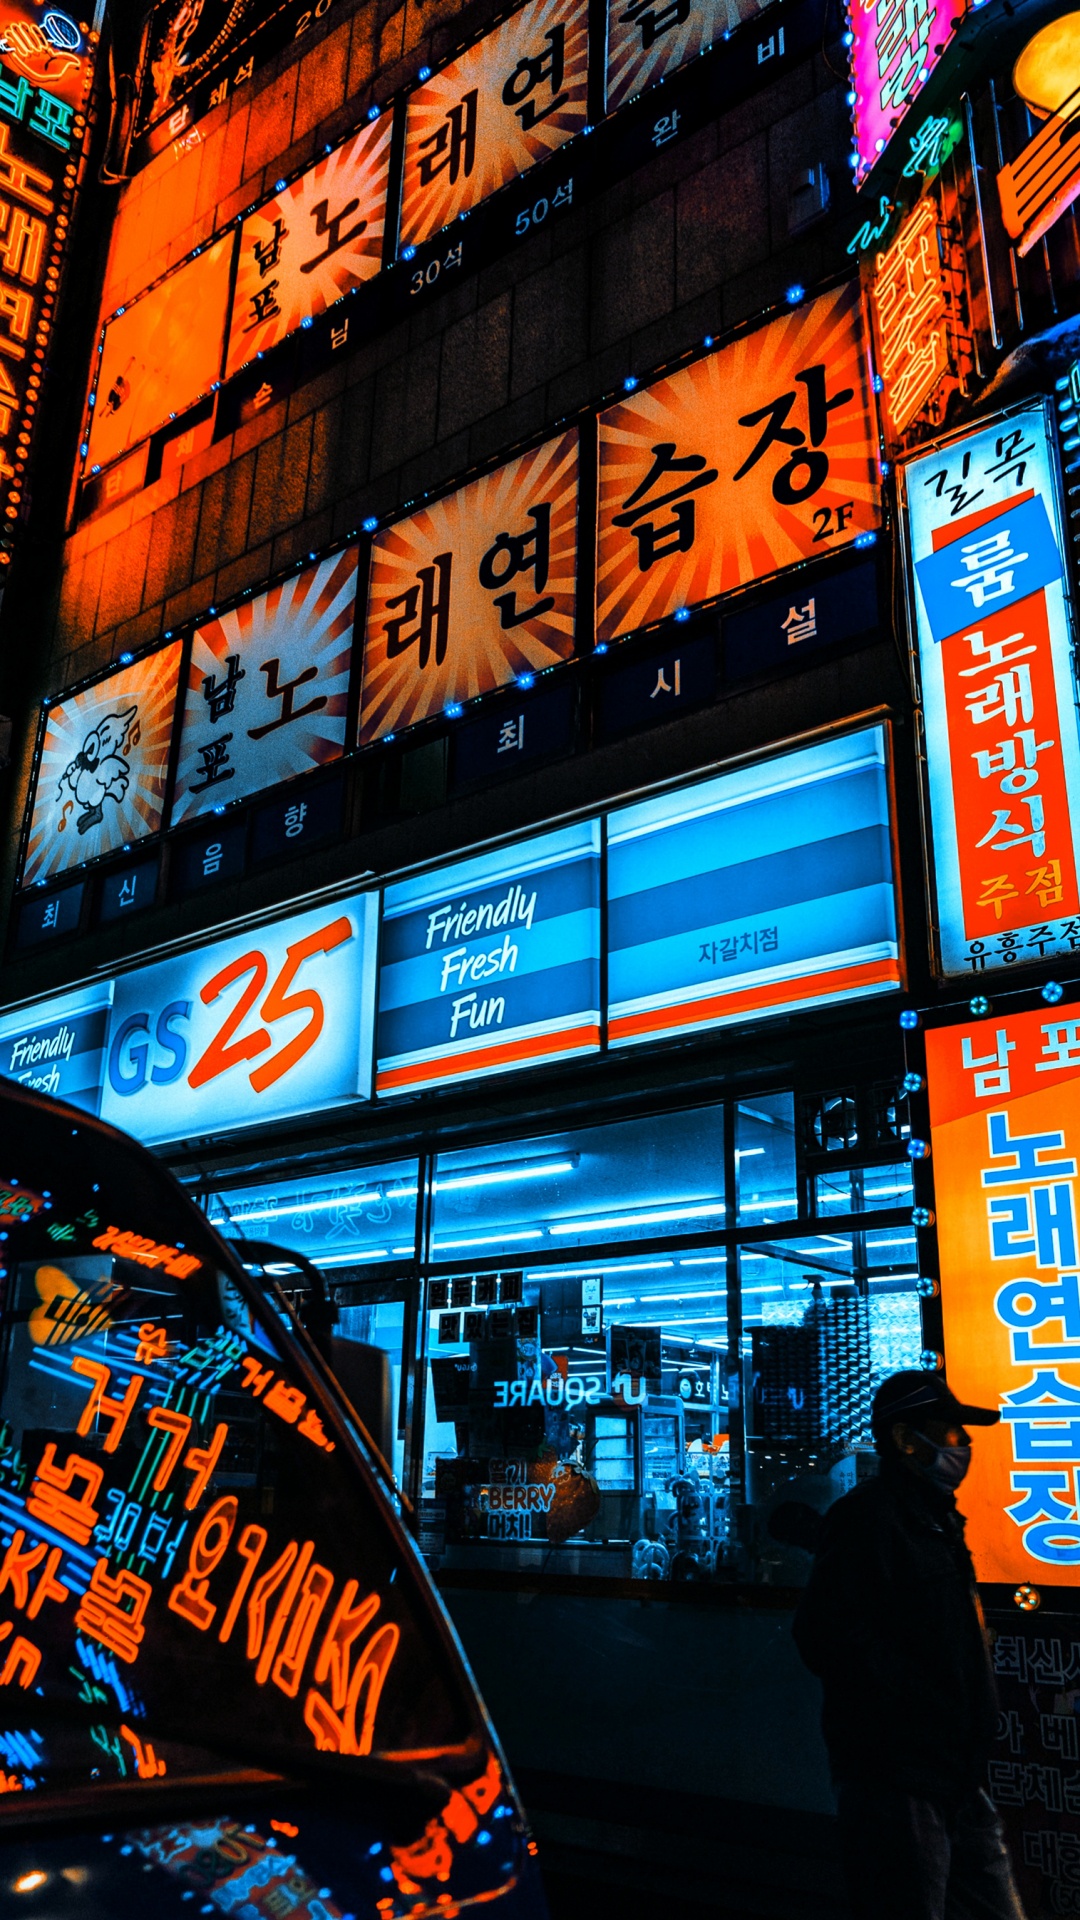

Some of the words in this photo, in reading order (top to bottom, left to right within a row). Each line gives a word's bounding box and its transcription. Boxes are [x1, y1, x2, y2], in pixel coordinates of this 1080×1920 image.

[410, 241, 463, 295] 30석
[515, 178, 573, 236] 50석
[242, 217, 290, 334] 남포
[924, 429, 1036, 517] 길목
[811, 500, 856, 543] 2F
[950, 529, 1030, 608] 룸
[188, 653, 246, 795] 남포
[957, 629, 1055, 859] 노래방식
[426, 884, 537, 949] Friendly
[976, 858, 1064, 921] 주점
[440, 936, 518, 992] Fresh
[698, 926, 780, 966] 자갈치점
[963, 916, 1080, 972] 유흥주점
[108, 916, 352, 1096] GS25
[450, 991, 504, 1038] Fun
[9, 1026, 75, 1071] Friendly
[488, 1484, 555, 1512] BERRY
